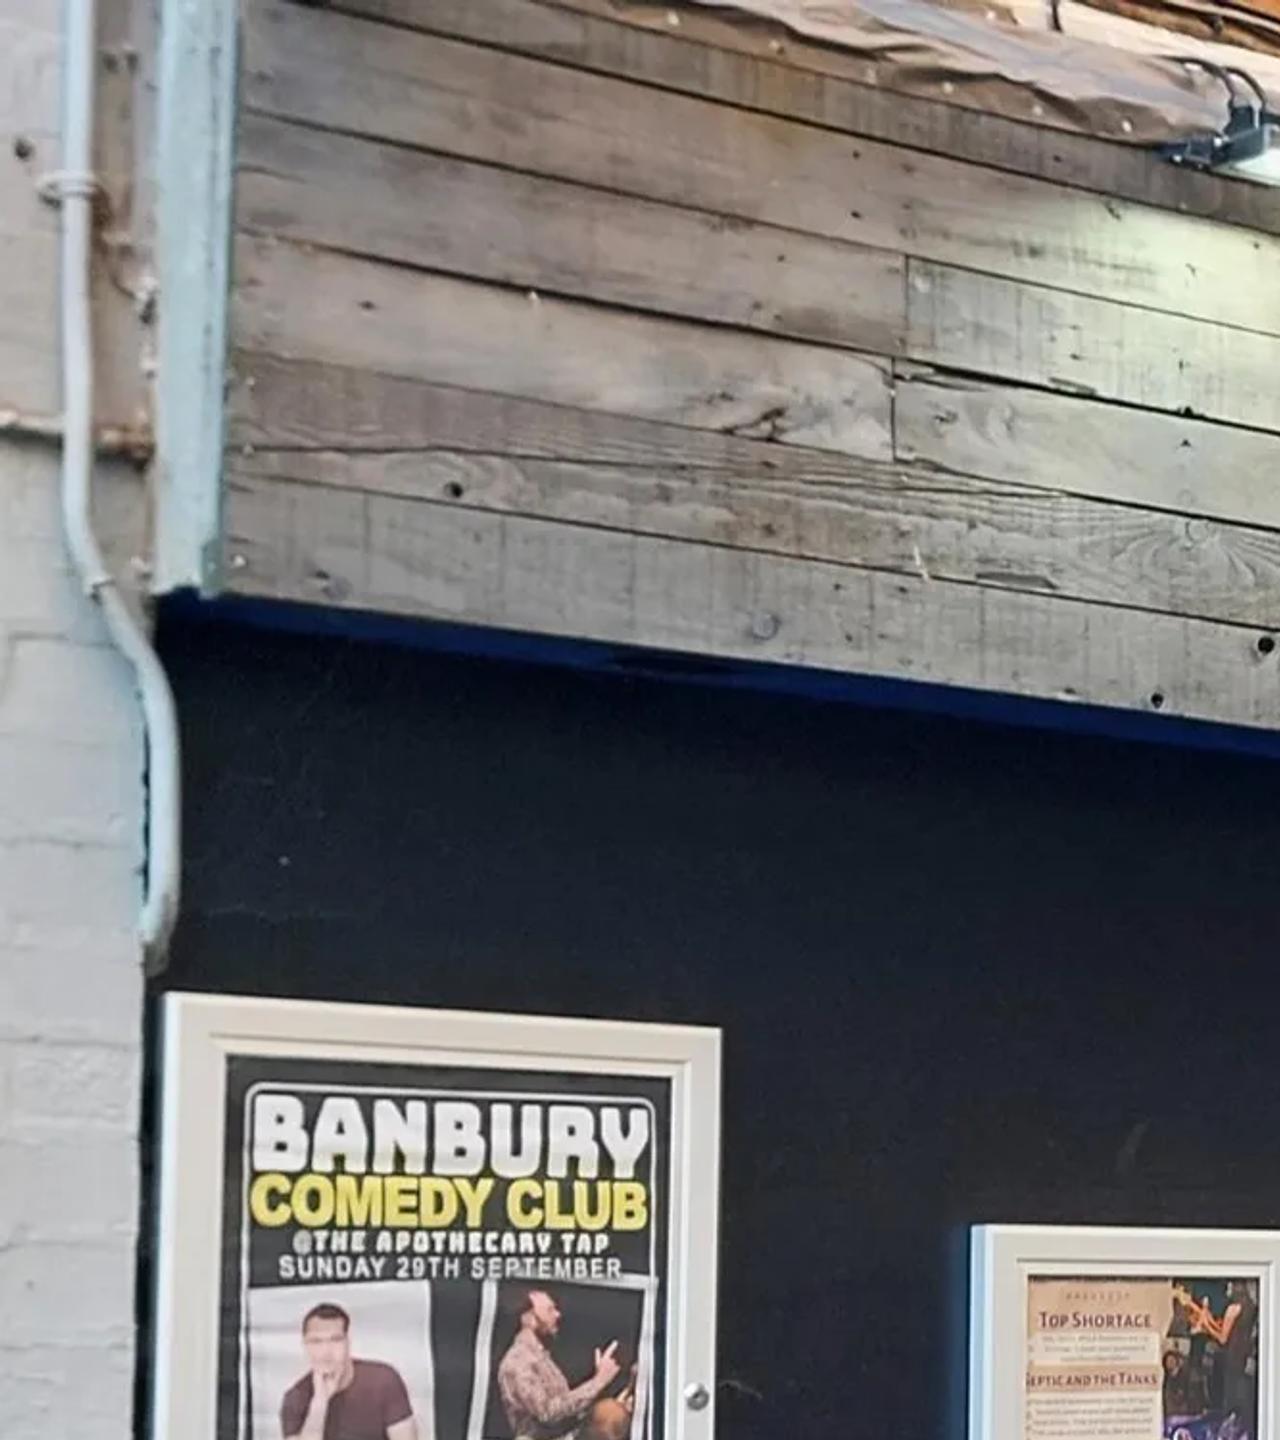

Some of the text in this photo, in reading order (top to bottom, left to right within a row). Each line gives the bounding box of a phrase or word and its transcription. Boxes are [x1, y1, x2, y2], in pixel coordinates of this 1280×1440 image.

[252, 1094, 650, 1179] BANBURY
[250, 1173, 649, 1231] COMEDY CLUB
[376, 1230, 551, 1255] APOTHECARY
[562, 1232, 609, 1255] TAP
[278, 1255, 622, 1279] SUNDAY 29TH SEPTEMBER
